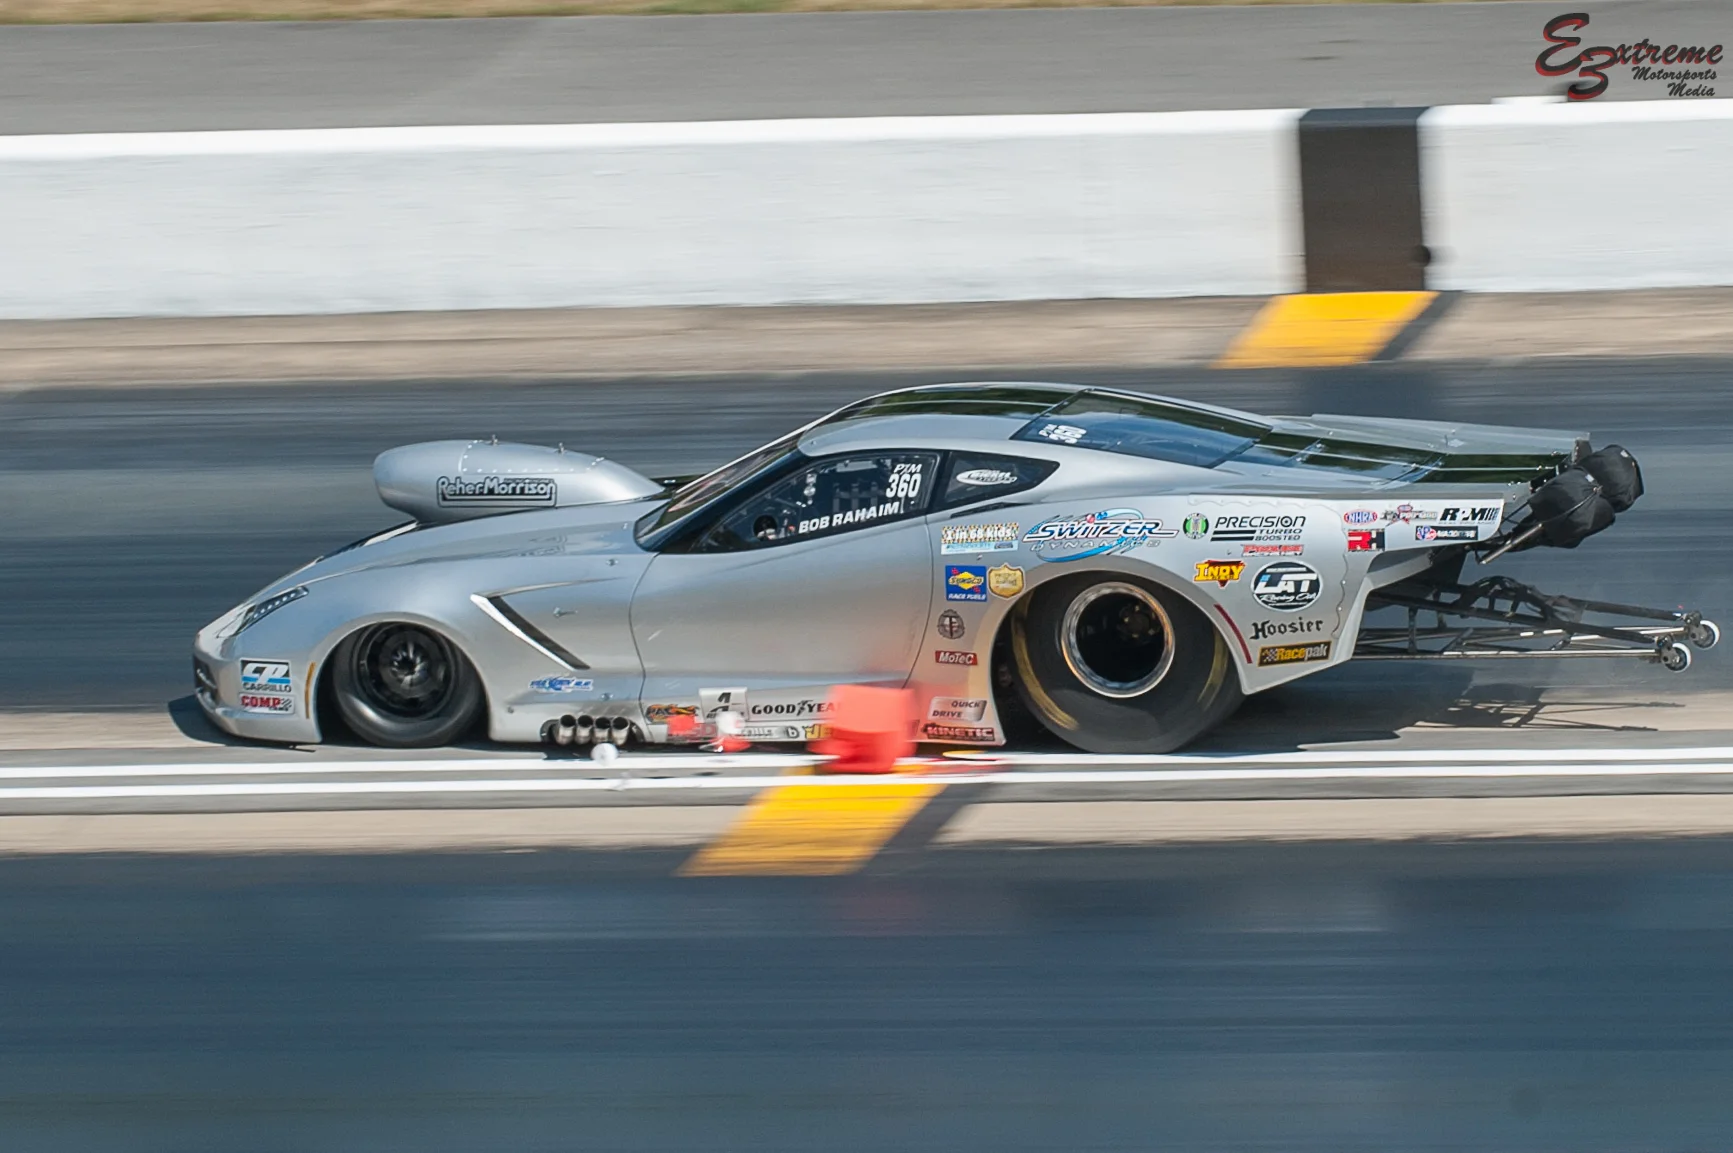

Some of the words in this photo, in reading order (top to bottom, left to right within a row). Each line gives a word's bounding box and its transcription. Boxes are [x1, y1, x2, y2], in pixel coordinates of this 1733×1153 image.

[886, 473, 922, 498] 360
[799, 516, 831, 534] BOB
[832, 501, 900, 527] RAHAIM
[1215, 516, 1306, 528] PRECISION
[1348, 511, 1373, 523] NHRA
[1023, 519, 1179, 542] SWITZER
[1194, 562, 1245, 581] INDY
[1249, 616, 1323, 640] Hoosier
[939, 651, 974, 664] MoTeC
[1276, 644, 1329, 662] Racepak
[243, 662, 289, 684] CP
[243, 682, 292, 693] CARRILLO
[241, 695, 281, 707] COMP
[951, 700, 980, 708] QUICK
[932, 710, 962, 718] DRIVE
[926, 726, 993, 737] KINETIC
